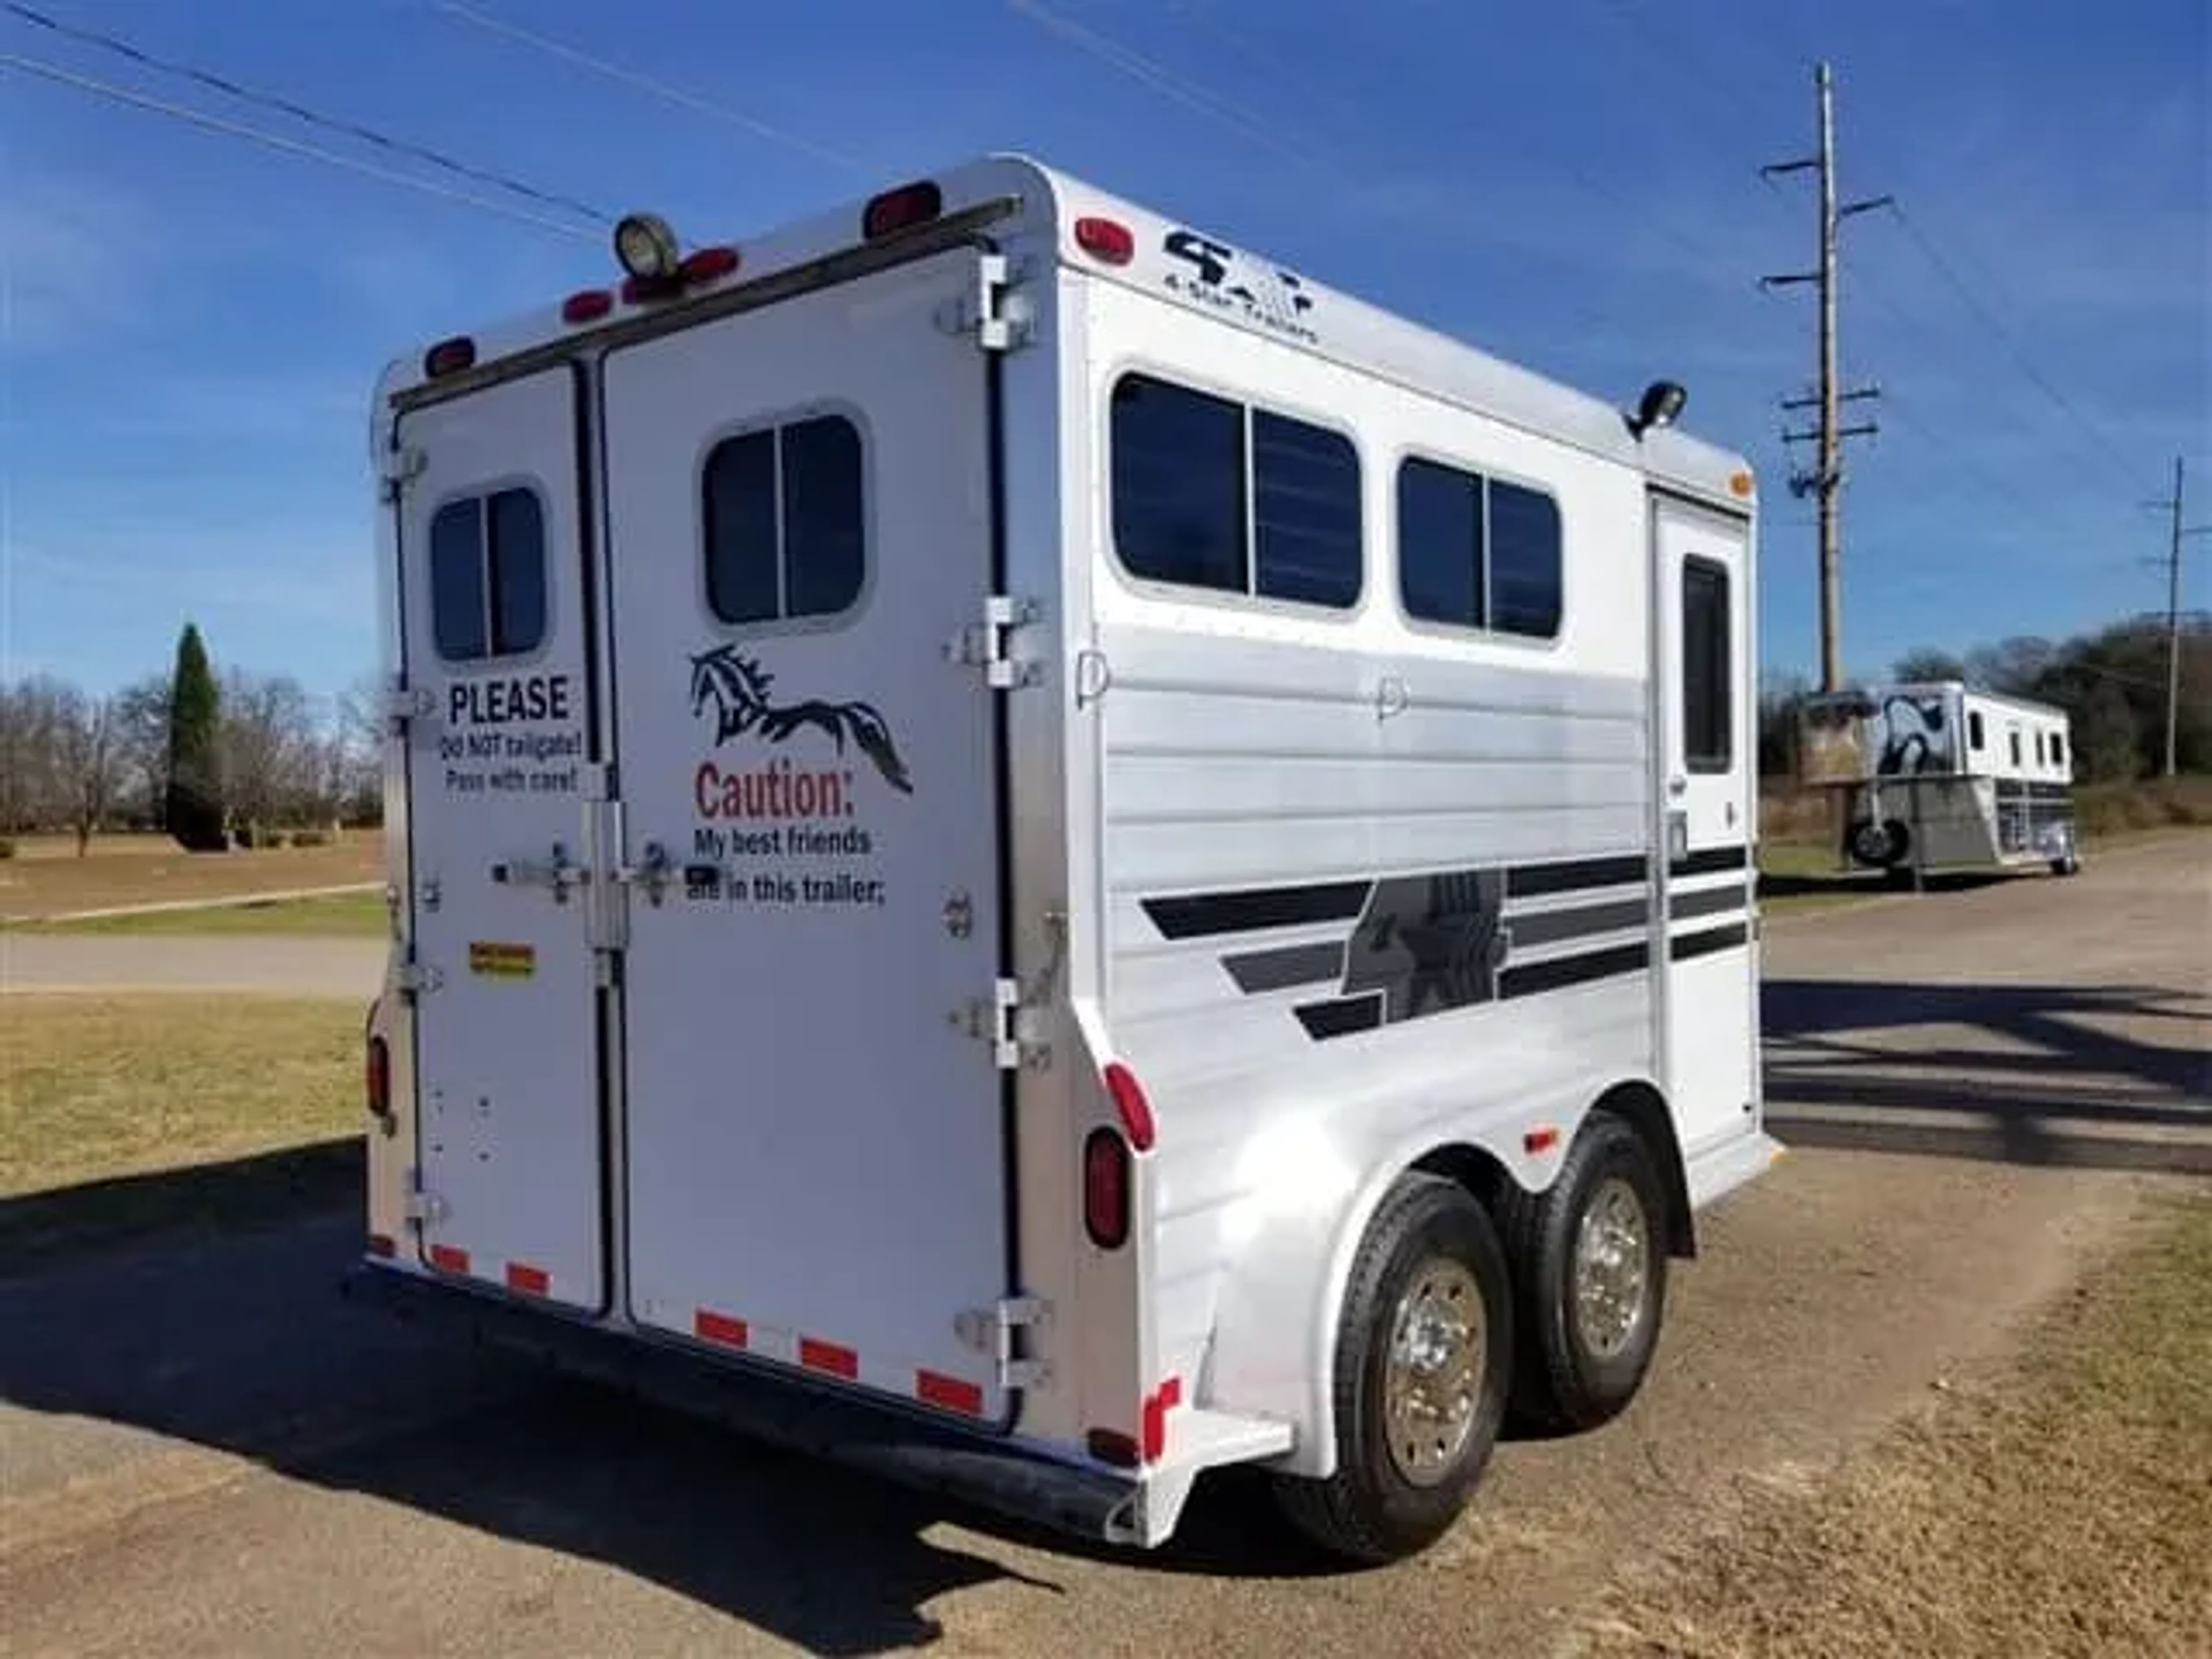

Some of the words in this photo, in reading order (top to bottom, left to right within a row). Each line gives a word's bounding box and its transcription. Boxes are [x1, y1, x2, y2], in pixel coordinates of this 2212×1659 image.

[449, 675, 569, 725] PLEASE
[468, 732, 502, 757] NOT
[490, 767, 525, 791] with
[695, 757, 855, 819] Caution:
[694, 828, 725, 859] My
[732, 828, 781, 855] best
[787, 825, 872, 855] friends
[727, 873, 747, 900] in
[752, 872, 797, 903] this
